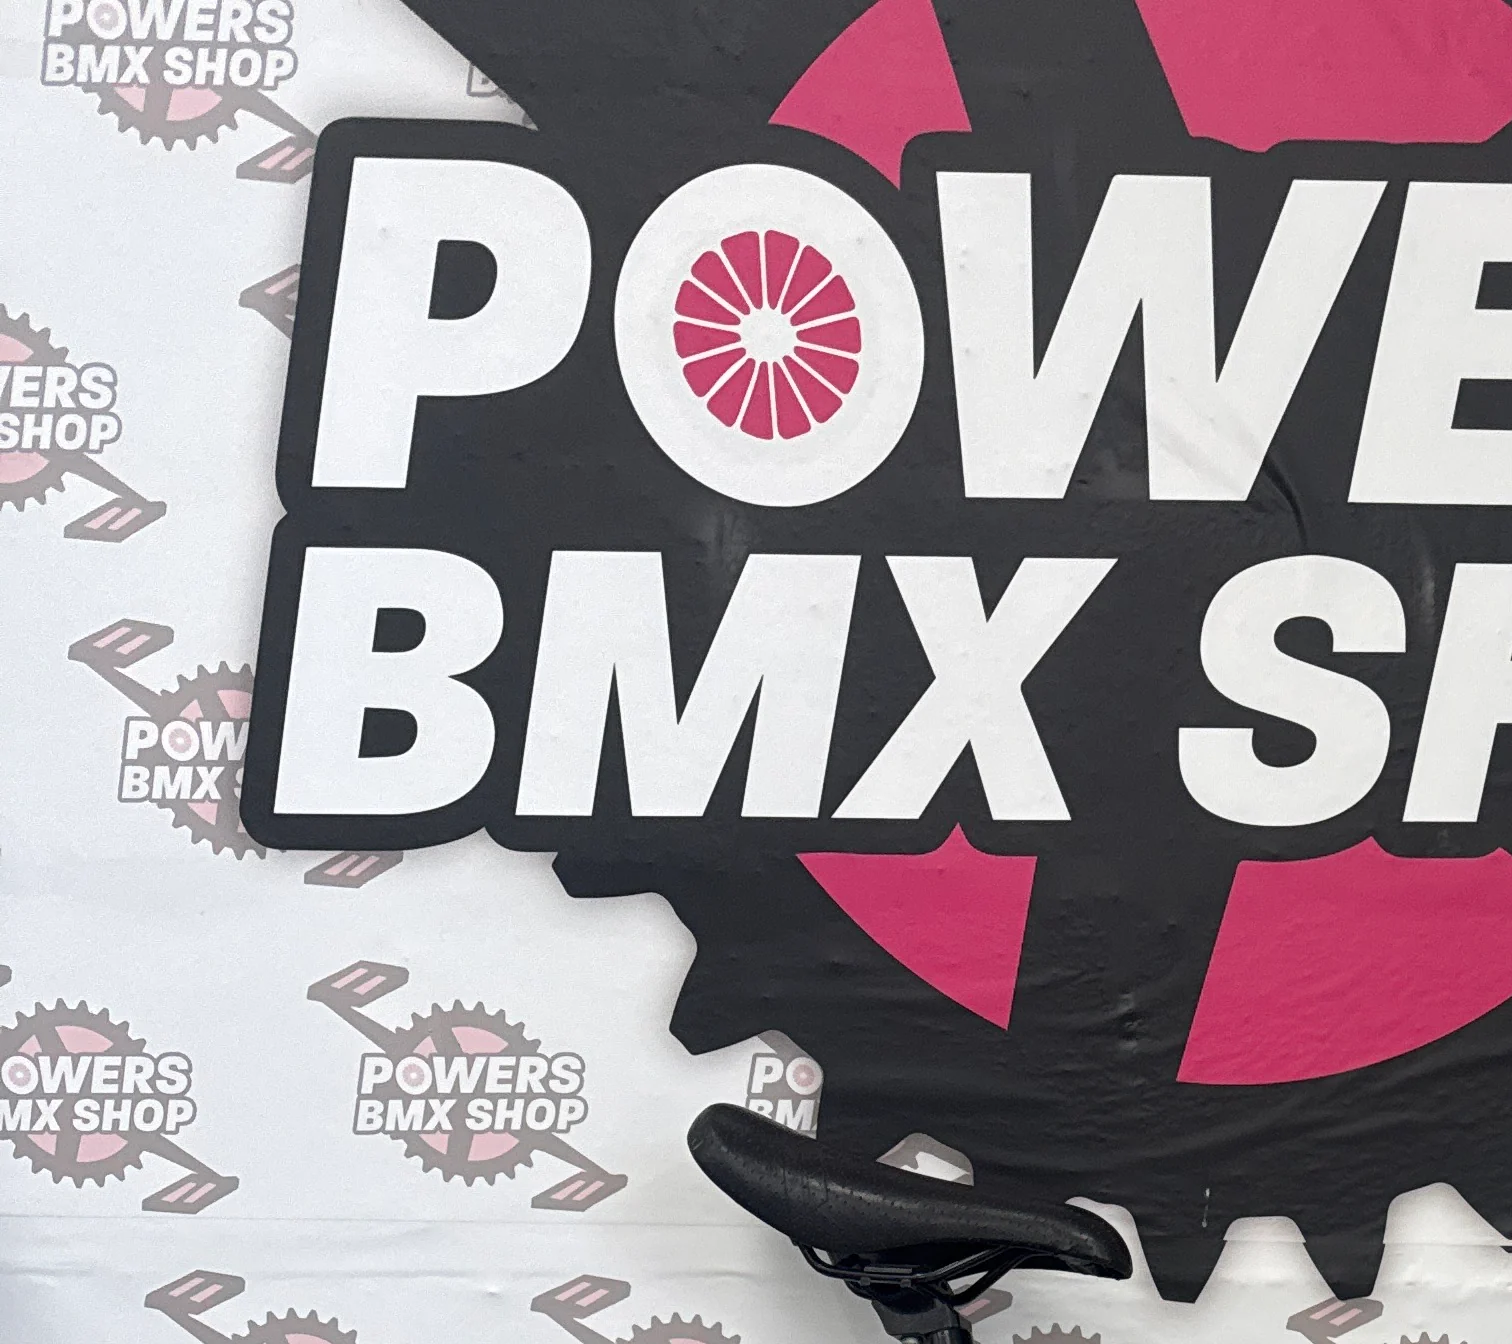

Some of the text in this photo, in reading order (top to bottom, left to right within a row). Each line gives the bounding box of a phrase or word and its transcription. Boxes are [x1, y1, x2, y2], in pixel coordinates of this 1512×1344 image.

[49, 1, 289, 43] POWERS
[46, 47, 293, 86] BMX SHOP
[0, 366, 115, 408] ERS
[0, 414, 118, 450] SHOP
[273, 546, 1117, 819] BMX
[126, 721, 249, 760] POW
[121, 766, 224, 800] BMX
[1, 1056, 187, 1094] OWERS
[362, 1057, 580, 1094] POWERS
[0, 1099, 192, 1131] MX SHOP
[358, 1099, 583, 1130] BMX SHOP
[747, 1100, 818, 1131] BM
